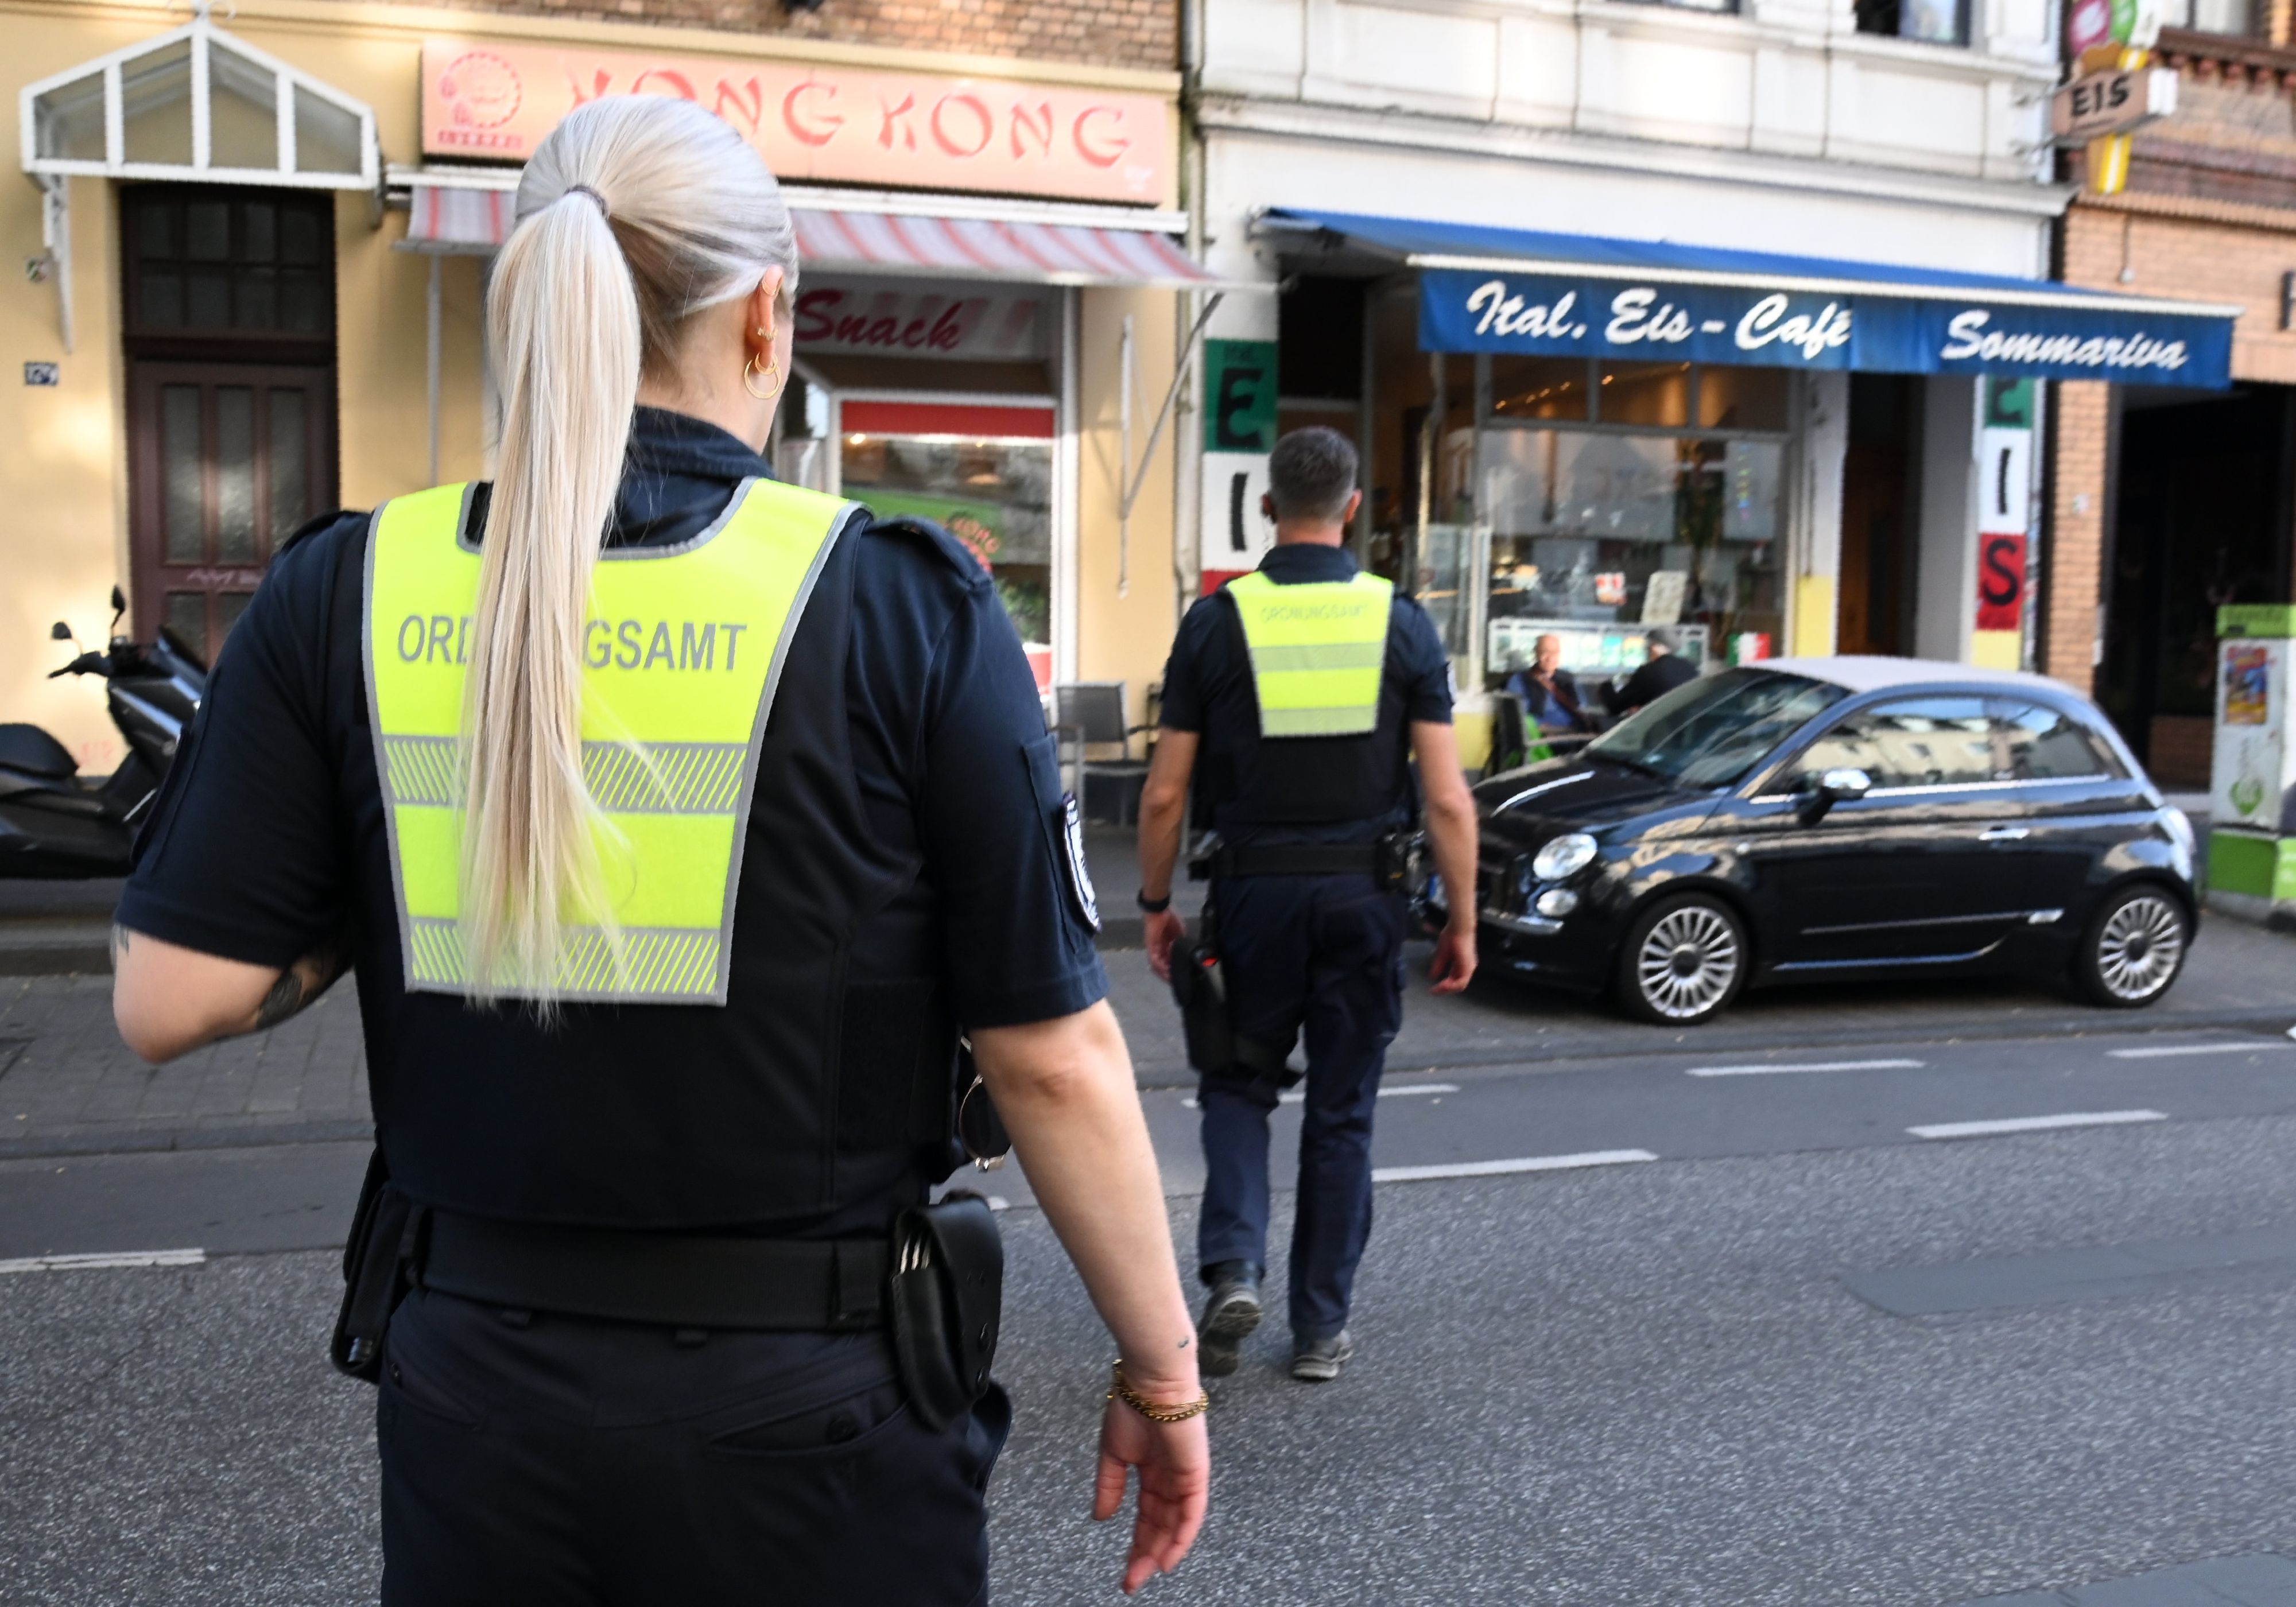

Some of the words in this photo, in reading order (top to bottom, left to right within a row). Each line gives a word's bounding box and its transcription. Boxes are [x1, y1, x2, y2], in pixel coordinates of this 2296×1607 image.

[2072, 73, 2130, 118] EIS
[878, 92, 1128, 168] KONG
[795, 289, 963, 351] Snack
[1467, 280, 1588, 340] Ital.
[1605, 287, 1694, 344] Eis
[1735, 293, 1852, 360] Café
[1940, 309, 2189, 370] Sommariva
[398, 615, 747, 671] ORDGSAMT
